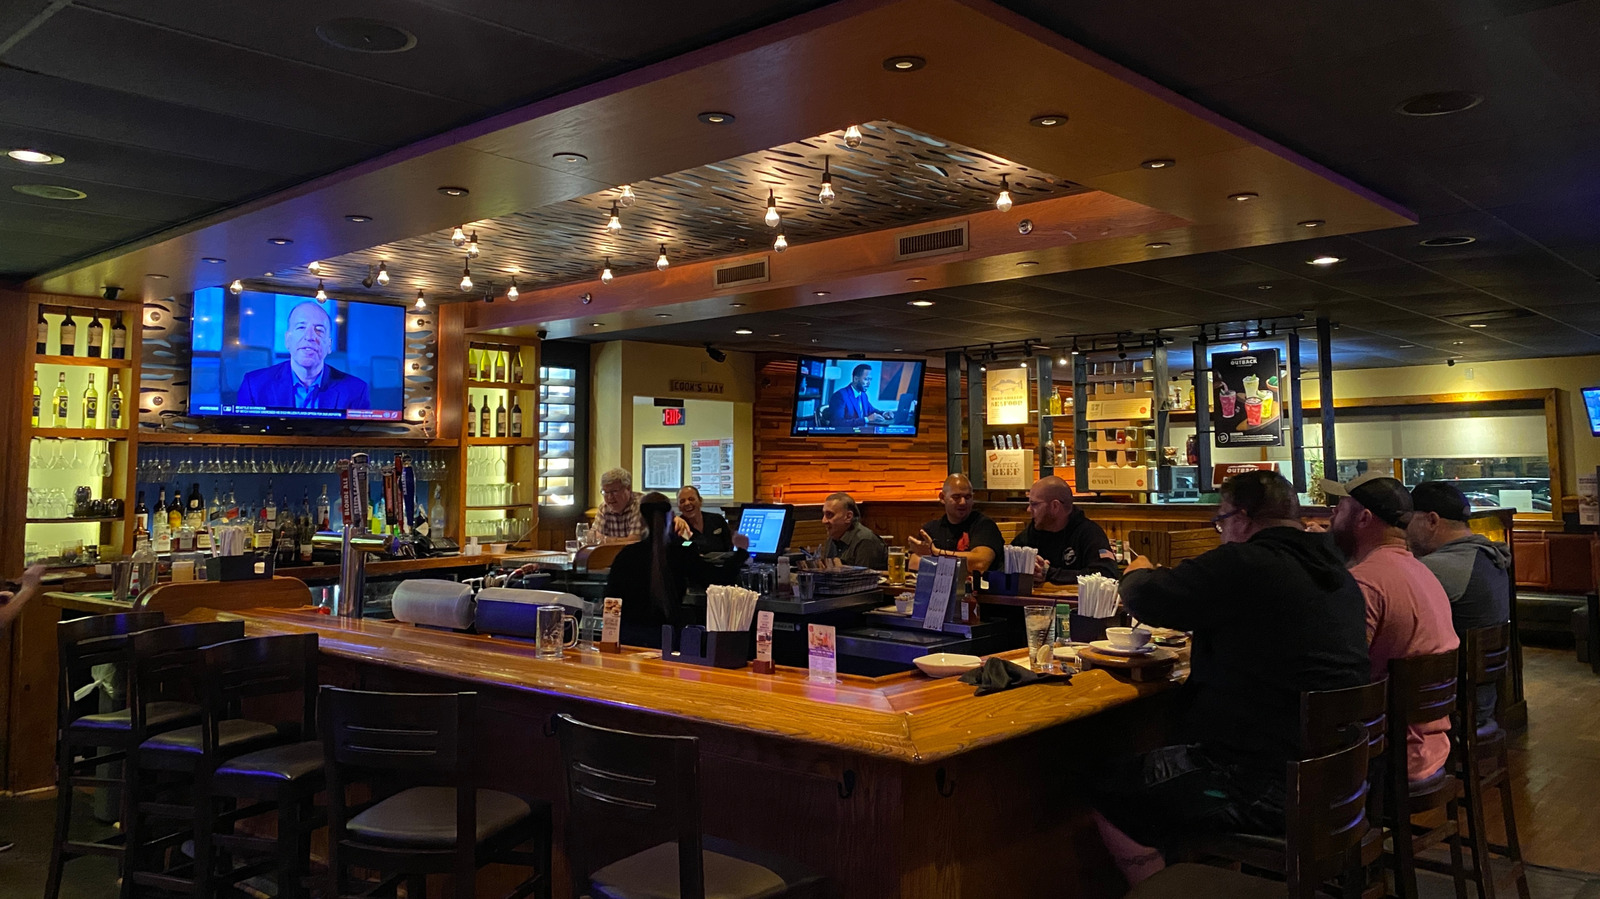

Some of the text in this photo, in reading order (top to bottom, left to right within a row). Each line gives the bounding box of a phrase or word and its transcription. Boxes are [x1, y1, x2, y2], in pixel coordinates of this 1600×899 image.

[674, 381, 724, 393] COOK'S WAY
[665, 409, 680, 425] EXIT
[992, 468, 1020, 476] BEEF
